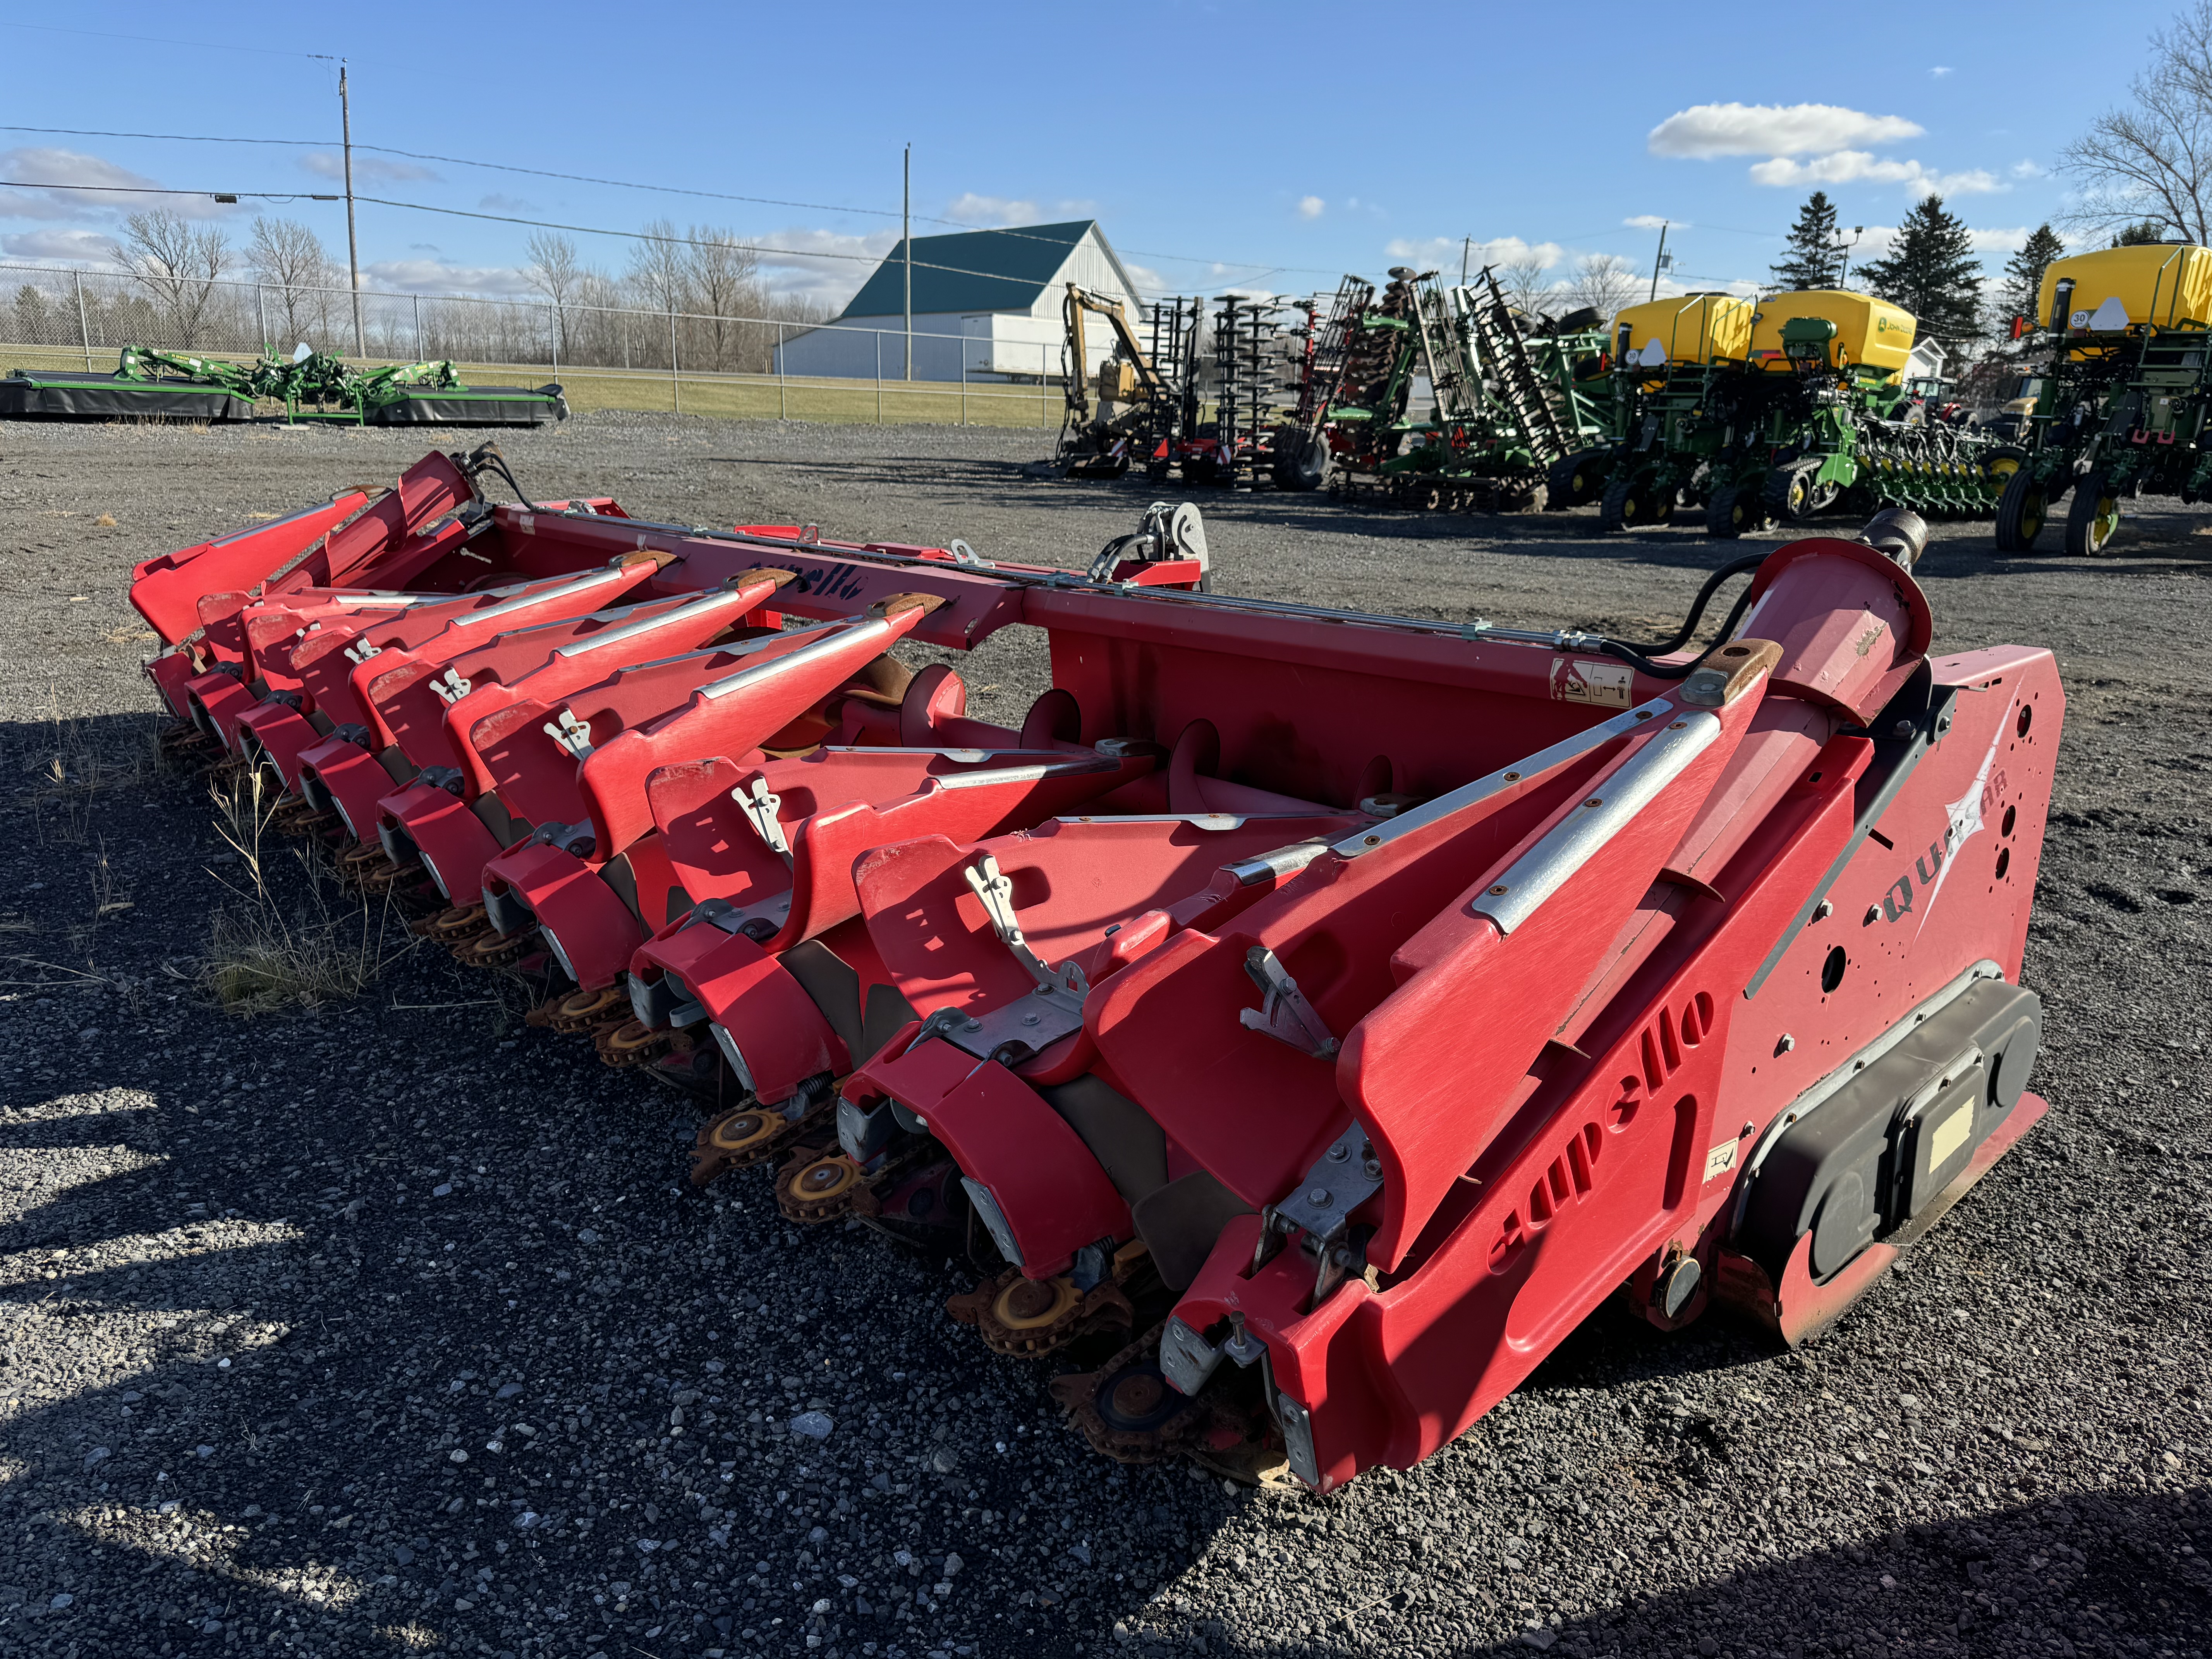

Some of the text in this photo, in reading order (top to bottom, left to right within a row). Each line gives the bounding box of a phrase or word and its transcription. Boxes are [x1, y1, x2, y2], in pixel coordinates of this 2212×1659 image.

[1887, 322, 1900, 331] JOHN
[1883, 769, 2008, 923] QUASAR
[1488, 991, 1714, 1275] capello
